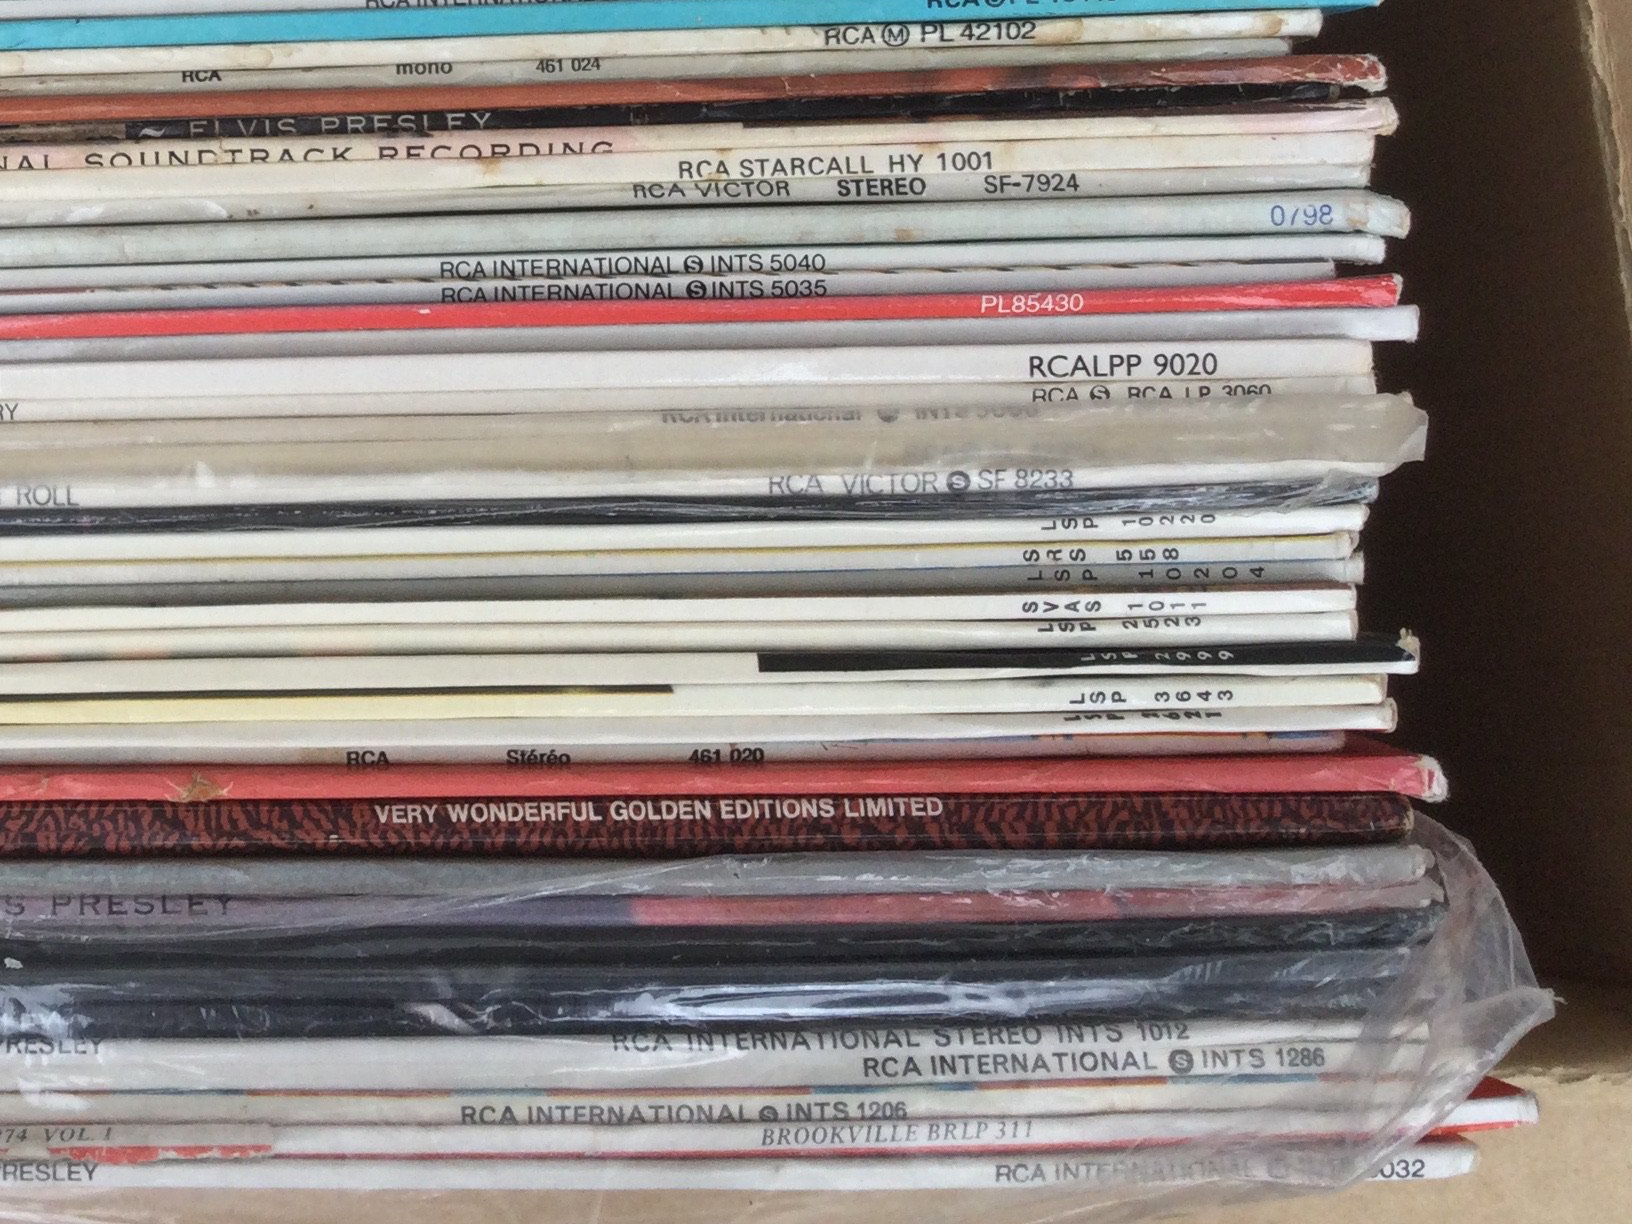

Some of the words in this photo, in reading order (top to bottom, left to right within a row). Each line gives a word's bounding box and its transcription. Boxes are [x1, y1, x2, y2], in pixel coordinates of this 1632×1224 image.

[961, 22, 1036, 40] 42102
[396, 60, 453, 77] mono
[536, 58, 564, 73] 461
[571, 57, 601, 72] 024
[678, 161, 730, 179] RCA
[739, 156, 874, 177] STARCALL
[888, 154, 923, 172] HY
[938, 151, 992, 171] 1001
[837, 178, 927, 197] STEREO
[984, 173, 1079, 194] SF-7924
[440, 261, 486, 279] RCA
[493, 257, 679, 276] INTERNATIONAL
[769, 254, 825, 271] 5040
[980, 294, 1084, 313] PL85430
[1030, 355, 1141, 377] RCALPP
[1154, 353, 1217, 375] 9020
[375, 804, 437, 824] VERY
[448, 801, 602, 823] WONDERFUL
[610, 800, 712, 821] GOLDEN
[721, 798, 835, 820] EDITIONS
[845, 797, 943, 818] LIMITED
[1276, 1047, 1324, 1067] 1286
[858, 1101, 907, 1121] 1206
[761, 1125, 917, 1147] BROOKVILLE
[996, 1119, 1034, 1139] 311
